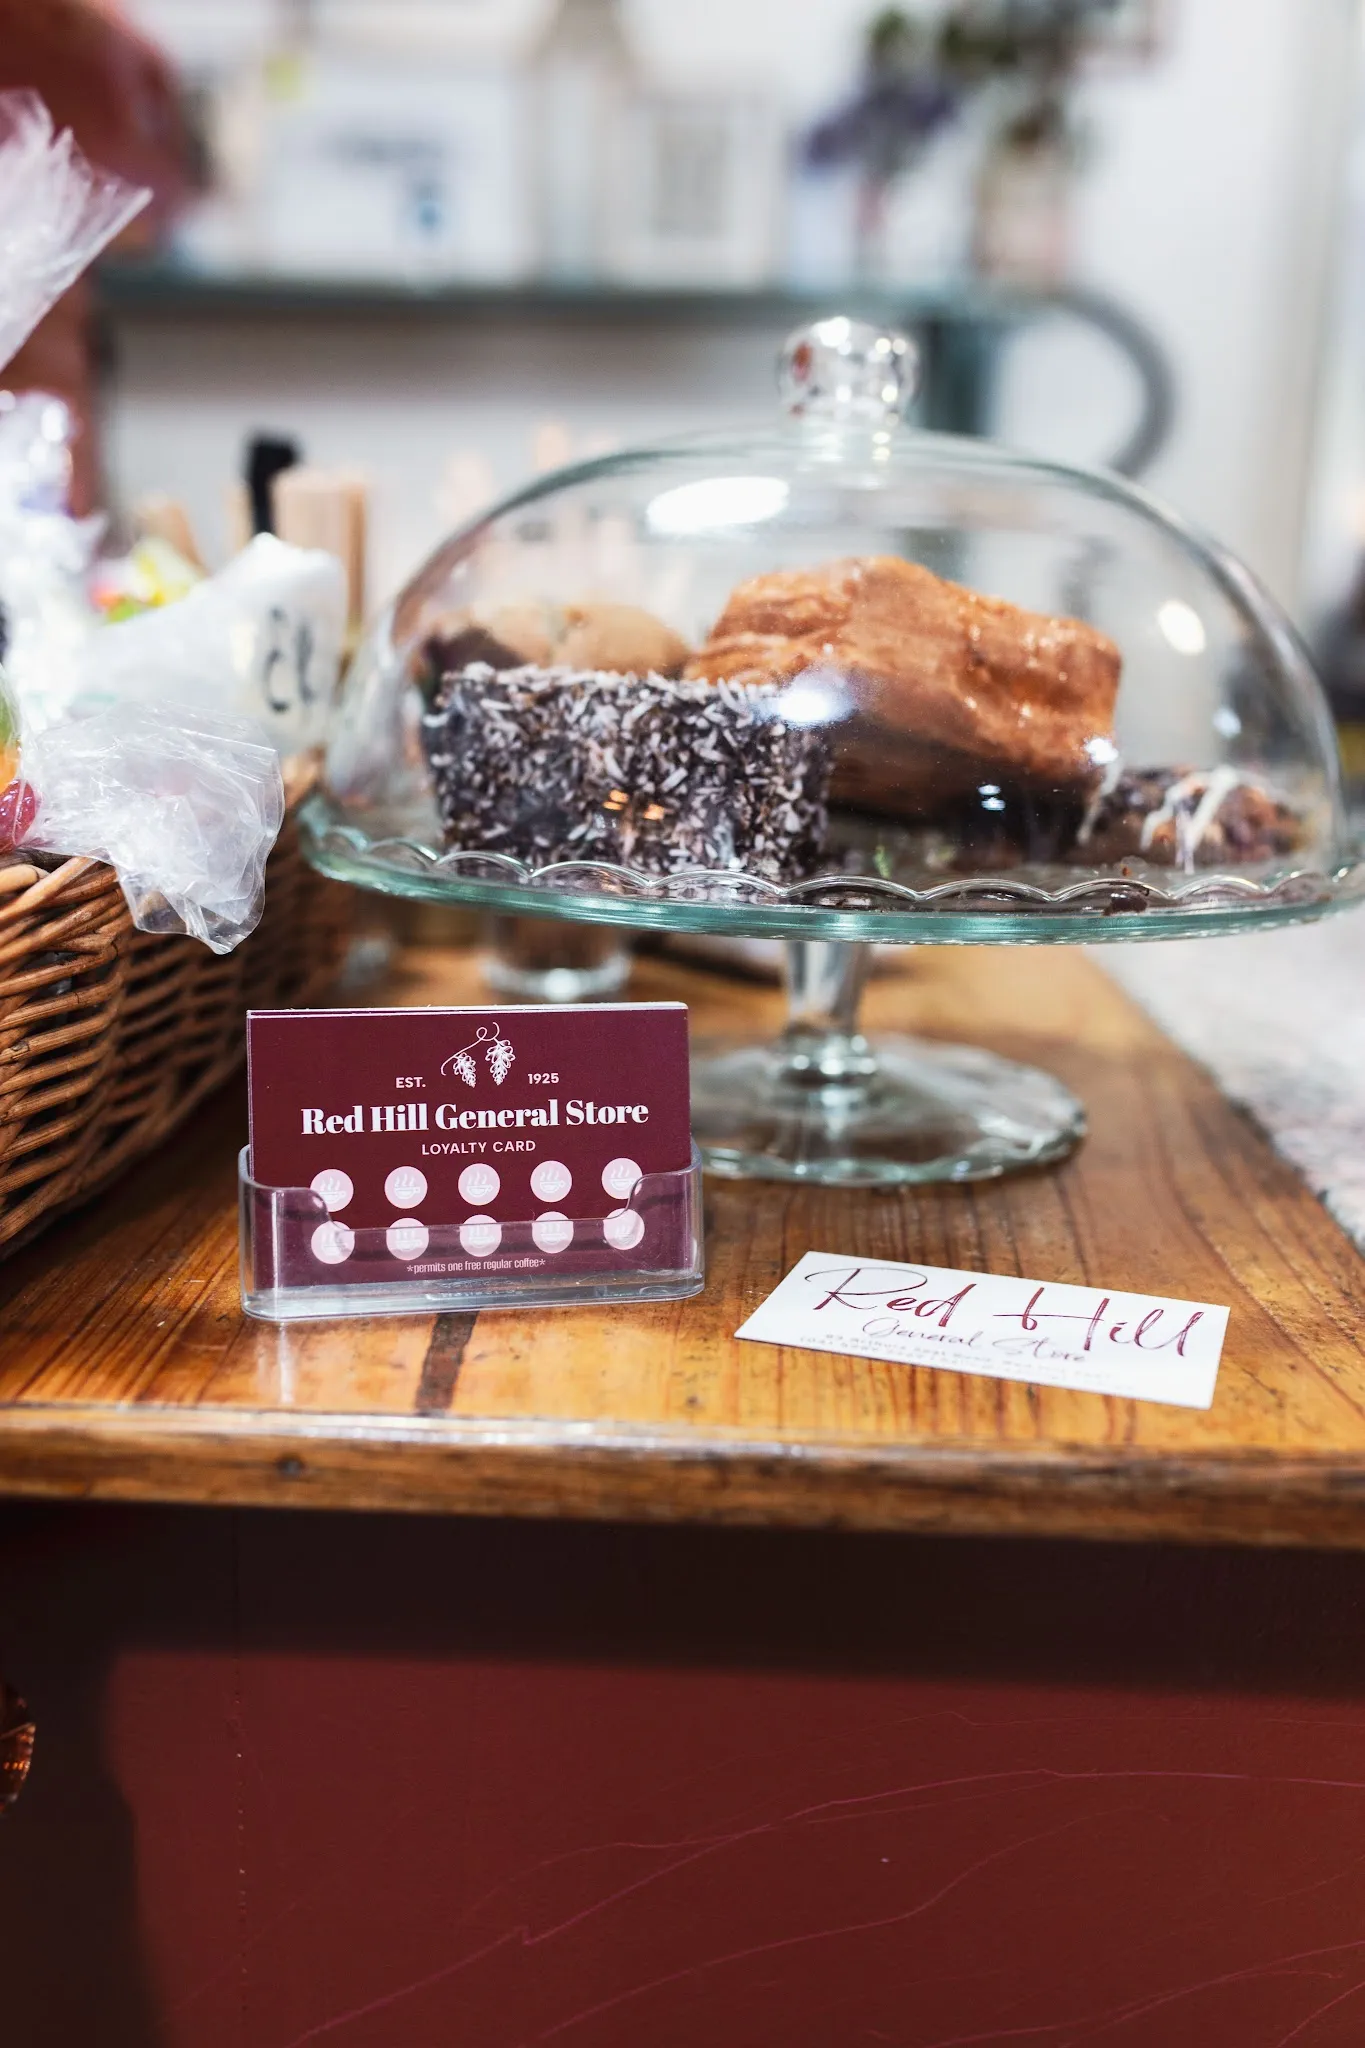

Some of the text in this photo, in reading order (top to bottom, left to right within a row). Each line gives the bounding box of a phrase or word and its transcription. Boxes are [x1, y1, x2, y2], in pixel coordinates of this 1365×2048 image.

[395, 1072, 560, 1089] EST. 1925
[300, 1098, 650, 1135] Red Hill General Store
[421, 1140, 537, 1156] LOYALTY CARD
[447, 1262, 464, 1272] one
[464, 1260, 482, 1271] free
[483, 1258, 513, 1271] regular
[804, 1266, 1205, 1357] Red Hill
[862, 1316, 985, 1349] General
[991, 1336, 1085, 1362] Store
